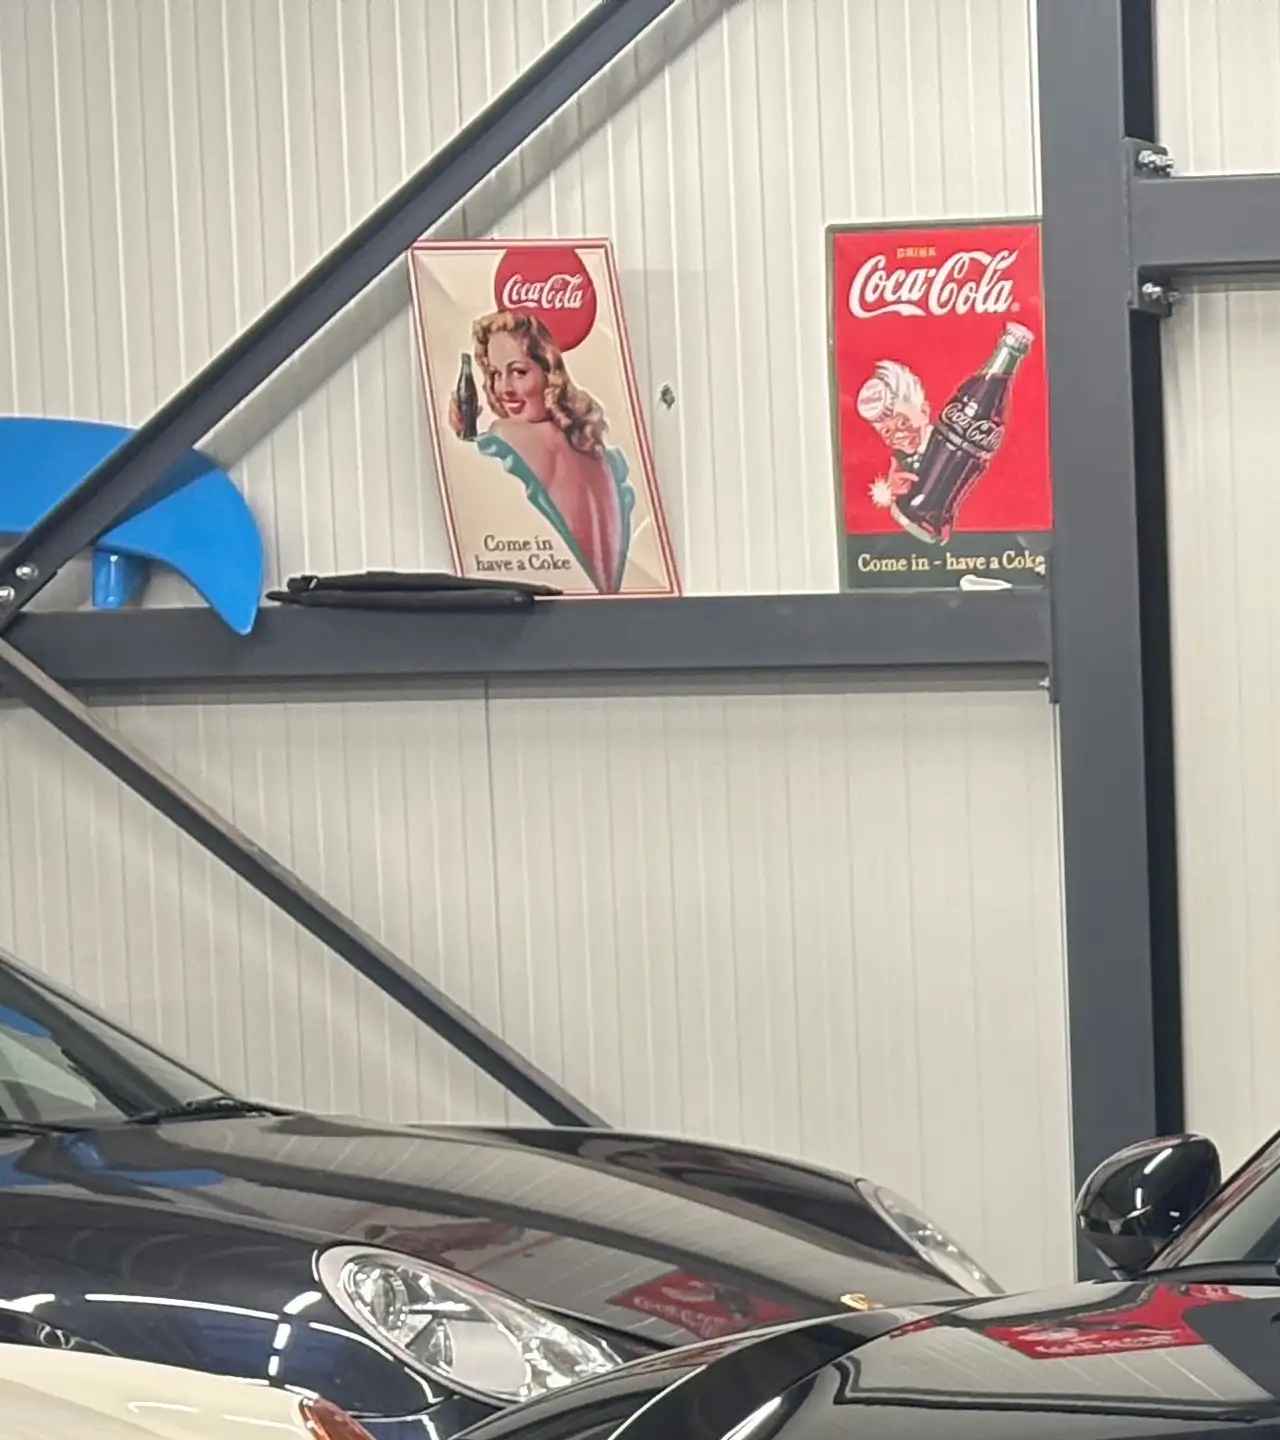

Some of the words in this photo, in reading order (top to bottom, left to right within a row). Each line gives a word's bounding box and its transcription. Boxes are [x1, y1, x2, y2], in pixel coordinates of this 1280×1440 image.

[897, 247, 936, 258] DRINK
[849, 249, 1019, 318] Coca-Cola
[484, 535, 532, 552] Come
[535, 534, 553, 551] in
[475, 555, 514, 572] have
[517, 559, 526, 571] a
[529, 553, 571, 571] Coke
[858, 553, 908, 572] Come
[912, 553, 930, 571] in
[946, 552, 986, 570] have
[990, 556, 999, 569] a
[1002, 551, 1045, 569] Coke
